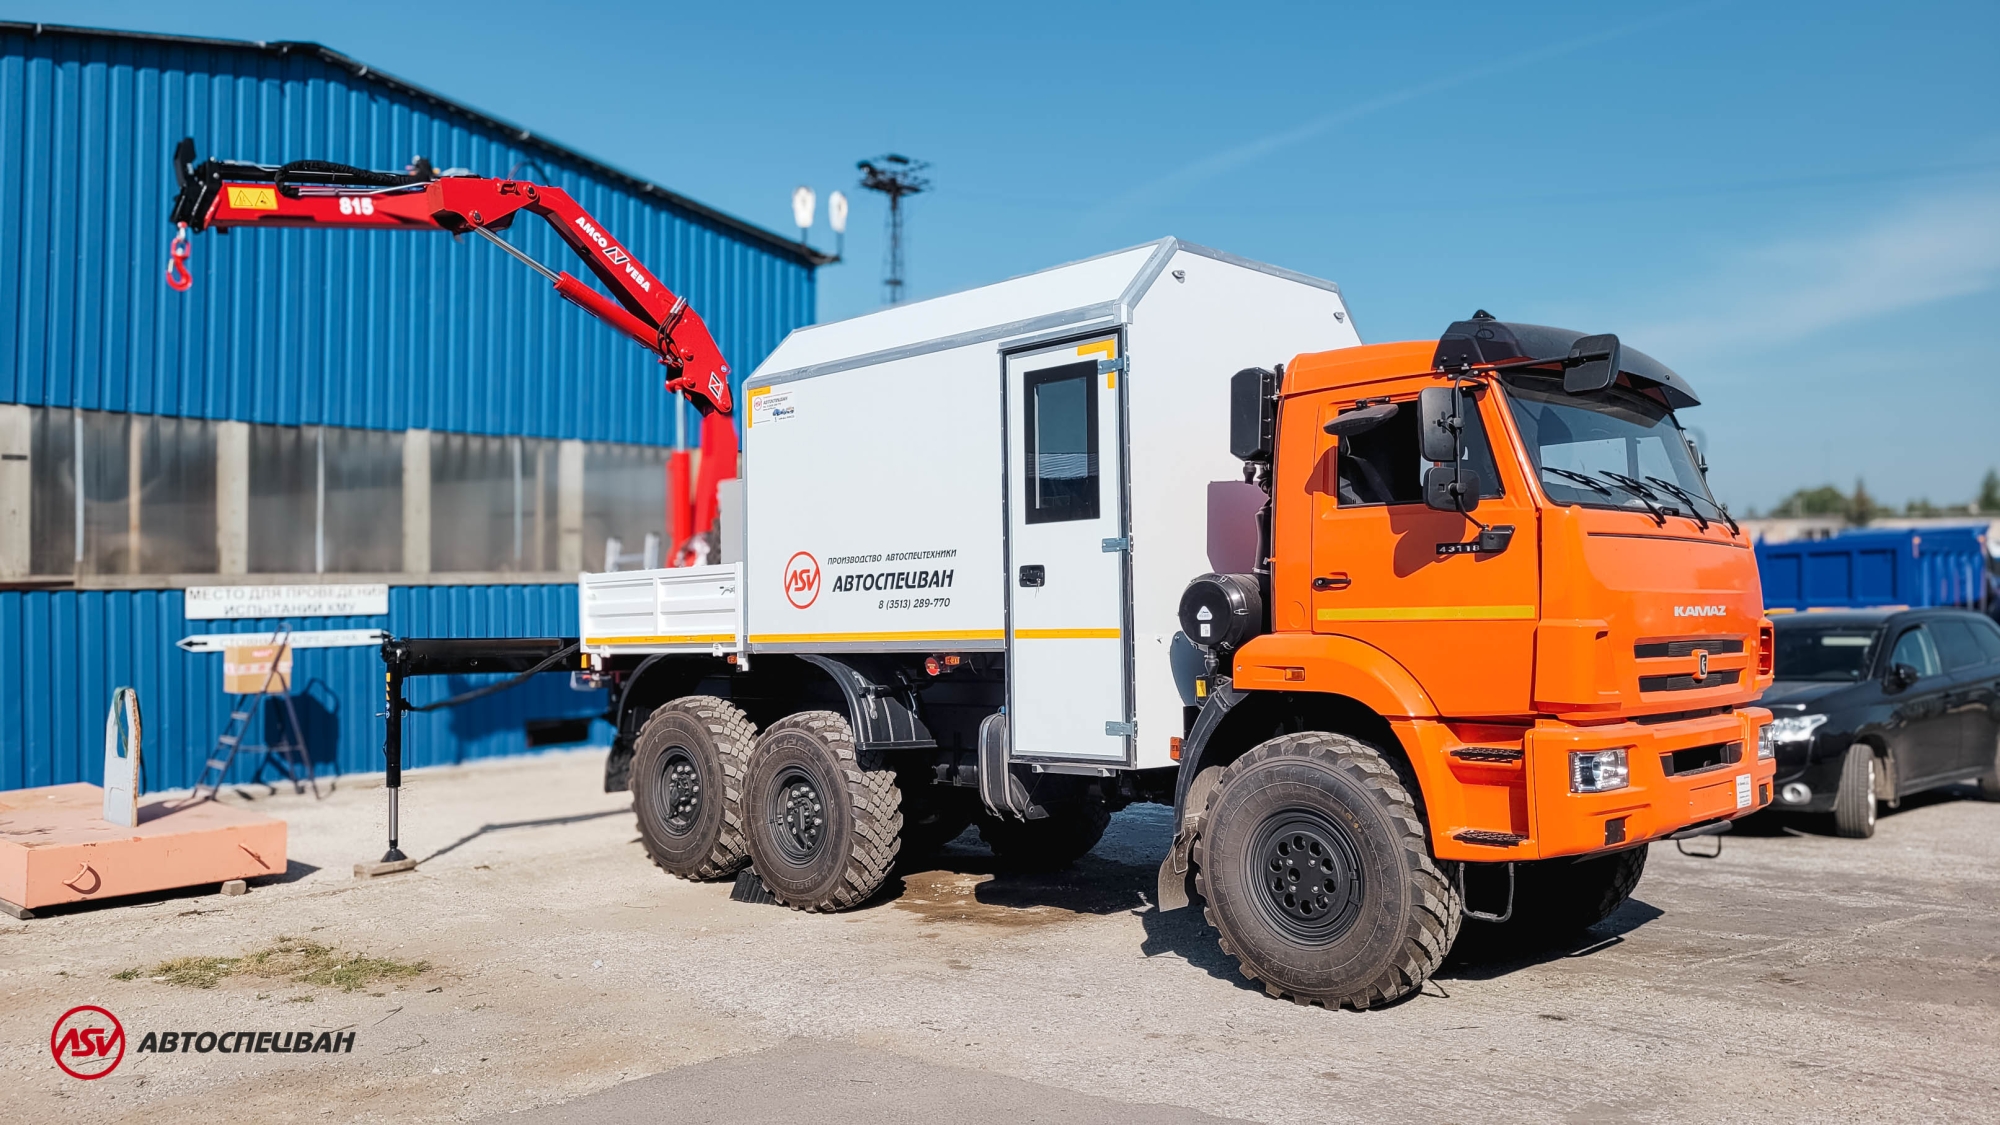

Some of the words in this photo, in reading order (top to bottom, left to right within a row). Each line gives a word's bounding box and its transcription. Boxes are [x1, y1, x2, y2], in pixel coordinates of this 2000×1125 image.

[339, 197, 374, 215] 815
[575, 217, 607, 248] AMCO
[625, 263, 651, 292] VEBA
[1439, 545, 1480, 553] 43118
[827, 554, 882, 565] ПРОИЗВОДСТВО
[885, 549, 957, 562] АВТОСПЕЦТЕХНИКИ
[832, 569, 954, 592] АВТОСПЕЦВАН
[189, 589, 245, 600] МЕСТО
[249, 587, 281, 600] ДЛЯ
[286, 585, 387, 599] ПРОВЕДЕНИЯ
[327, 601, 356, 614] КМУ
[878, 600, 884, 609] 8
[886, 600, 911, 610] (3513)
[913, 598, 951, 608] 289-770
[1674, 605, 1727, 617] KAMAZ
